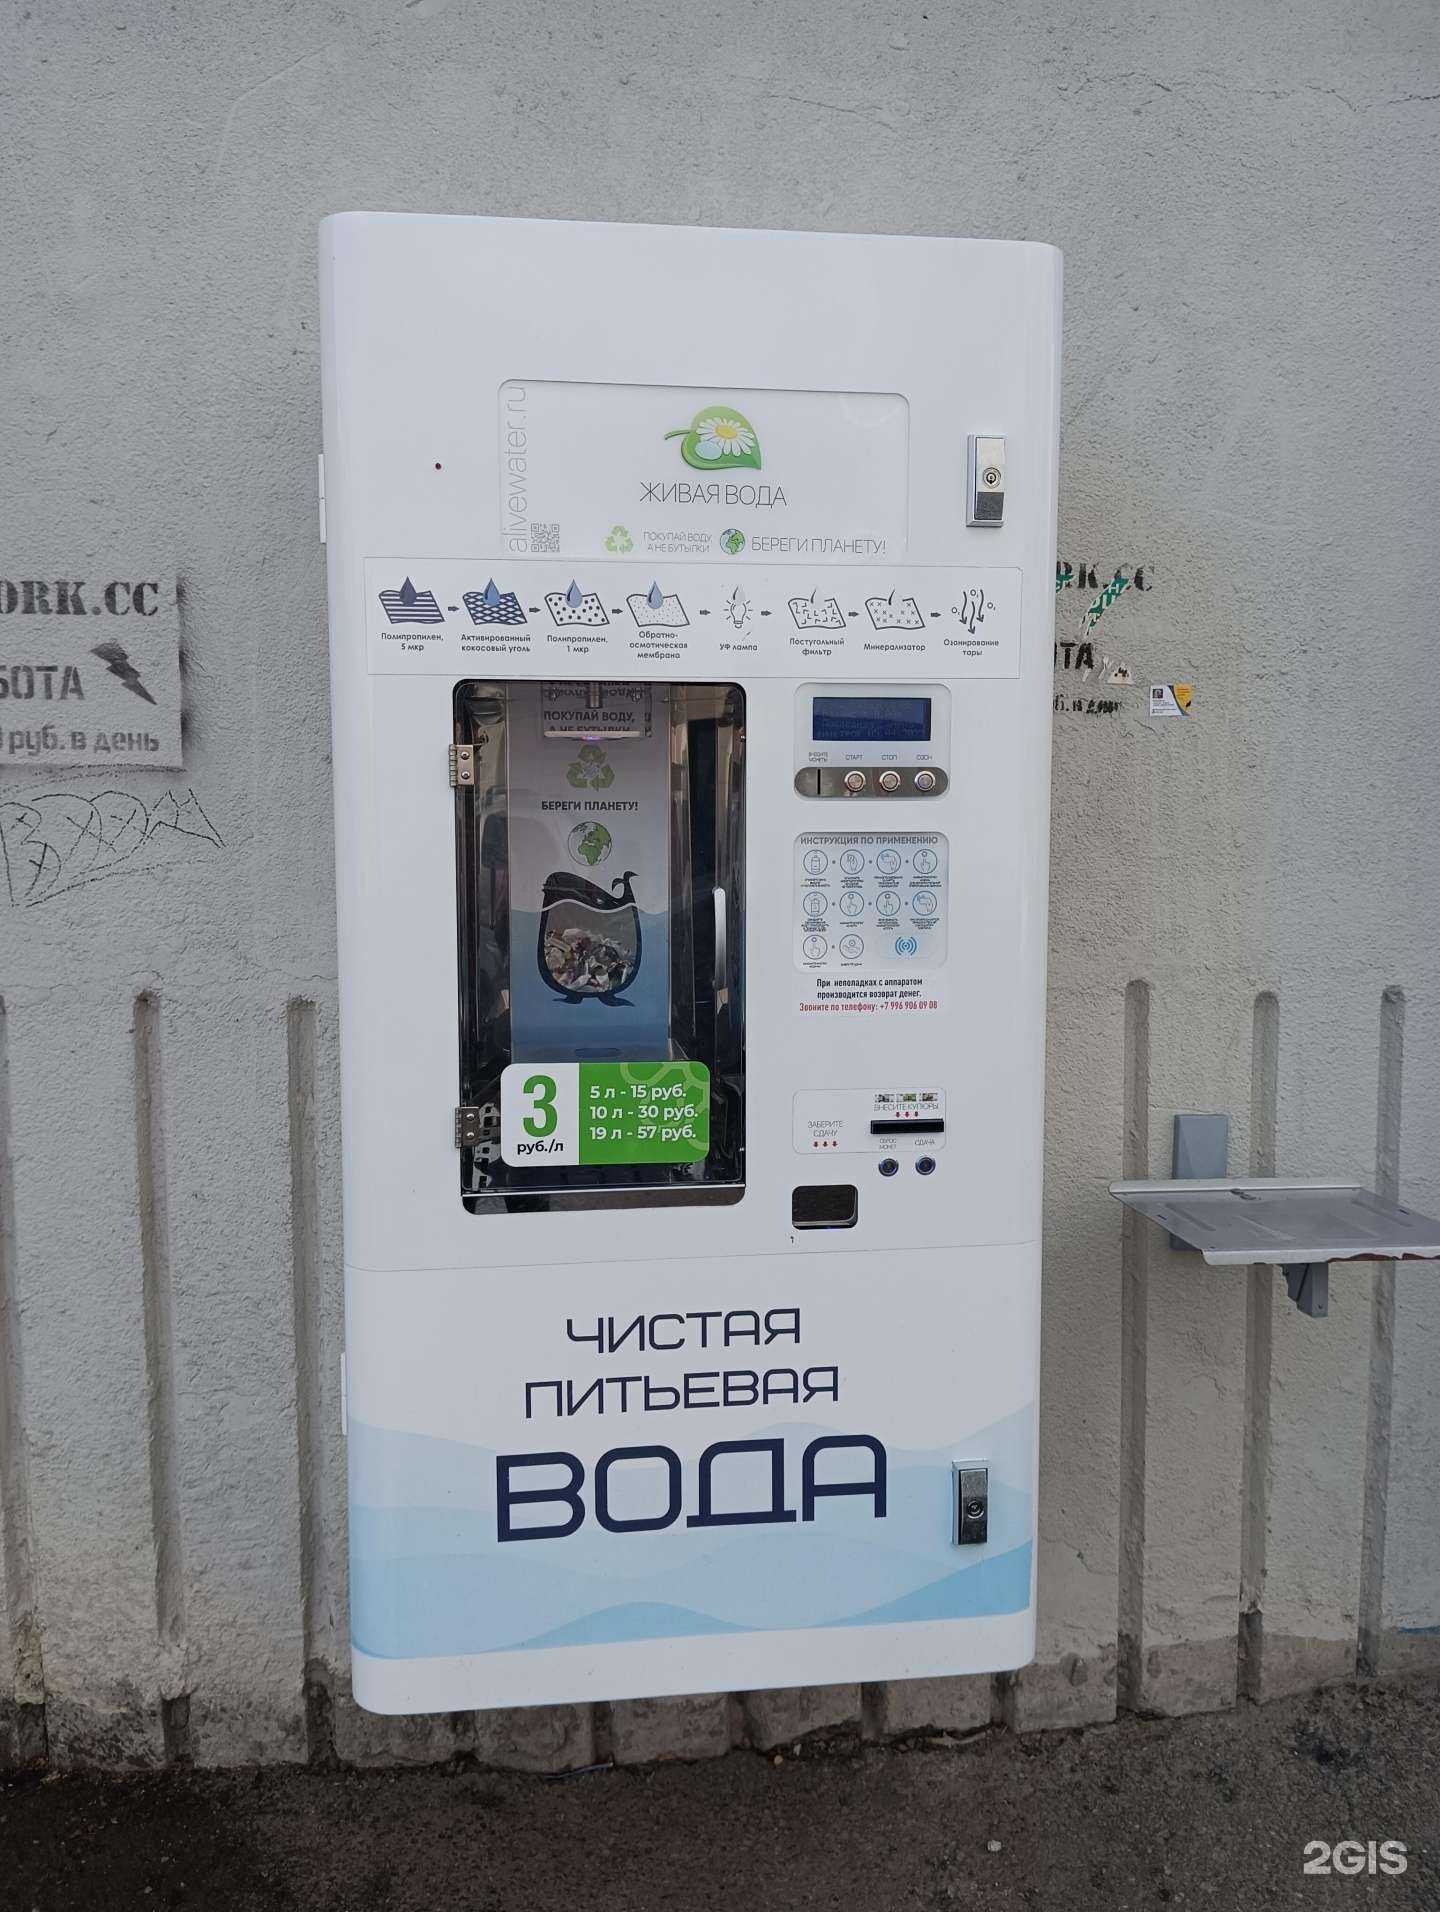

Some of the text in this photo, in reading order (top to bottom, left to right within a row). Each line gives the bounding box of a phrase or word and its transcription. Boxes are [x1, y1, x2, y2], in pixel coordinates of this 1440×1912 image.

[501, 385, 528, 553] alivewater.ru
[640, 482, 787, 508] ЖИВАЯ ВОДА
[751, 536, 887, 555] БЕРЕГИ ПЛАНЕТУ!
[382, 632, 443, 643] Полипропилен,
[461, 633, 531, 643] Активированный
[547, 634, 608, 645] Полипропилен,
[639, 631, 678, 642] Обратно-
[629, 641, 688, 650] осмотическая
[790, 638, 844, 647] Постугольный
[864, 643, 926, 652] Минерализатор
[944, 639, 999, 647] Озонирование
[462, 643, 530, 654] кокосовый уголь
[574, 646, 589, 654] мкр
[733, 645, 757, 653] лампа
[802, 647, 832, 656] фильтр
[963, 649, 982, 657] тары
[637, 651, 680, 660] мембрана
[543, 709, 635, 723] ПОКУПАЙ ВОДУ,
[9, 725, 65, 756] руб.
[71, 731, 87, 750] в
[94, 732, 160, 752] день
[541, 800, 638, 812] БЕРЕГИ ПЛАНЕТУ!
[801, 836, 938, 846] ИНСТРУКЦИЯ ПО ПРИМЕНЕНИЮ
[816, 978, 831, 988] При
[834, 979, 877, 988] неполадках
[885, 978, 923, 987] аппаратом
[817, 989, 922, 1000] производится возврат денег.
[800, 1003, 829, 1011] Звоните
[831, 1003, 840, 1011] по
[841, 1002, 877, 1012] телефону:
[590, 1085, 600, 1099] 5
[604, 1088, 616, 1099] л
[631, 1085, 647, 1098] 15
[651, 1084, 687, 1101] руб.
[523, 1075, 558, 1137] 3
[590, 1106, 608, 1119] 10
[611, 1109, 623, 1119] л
[638, 1106, 659, 1118] 30
[663, 1104, 698, 1121] руб.
[808, 1120, 843, 1128] ЗАБЕРИТЕ
[590, 1127, 607, 1140] 19
[611, 1129, 622, 1139] л
[638, 1126, 657, 1139] 57
[661, 1124, 696, 1141] руб.
[517, 1138, 564, 1155] руб./л
[566, 1308, 800, 1353] ЧИСТАЯ
[525, 1366, 838, 1419] ПИТЬЕВАЯ
[496, 1434, 887, 1542] ВОДА
